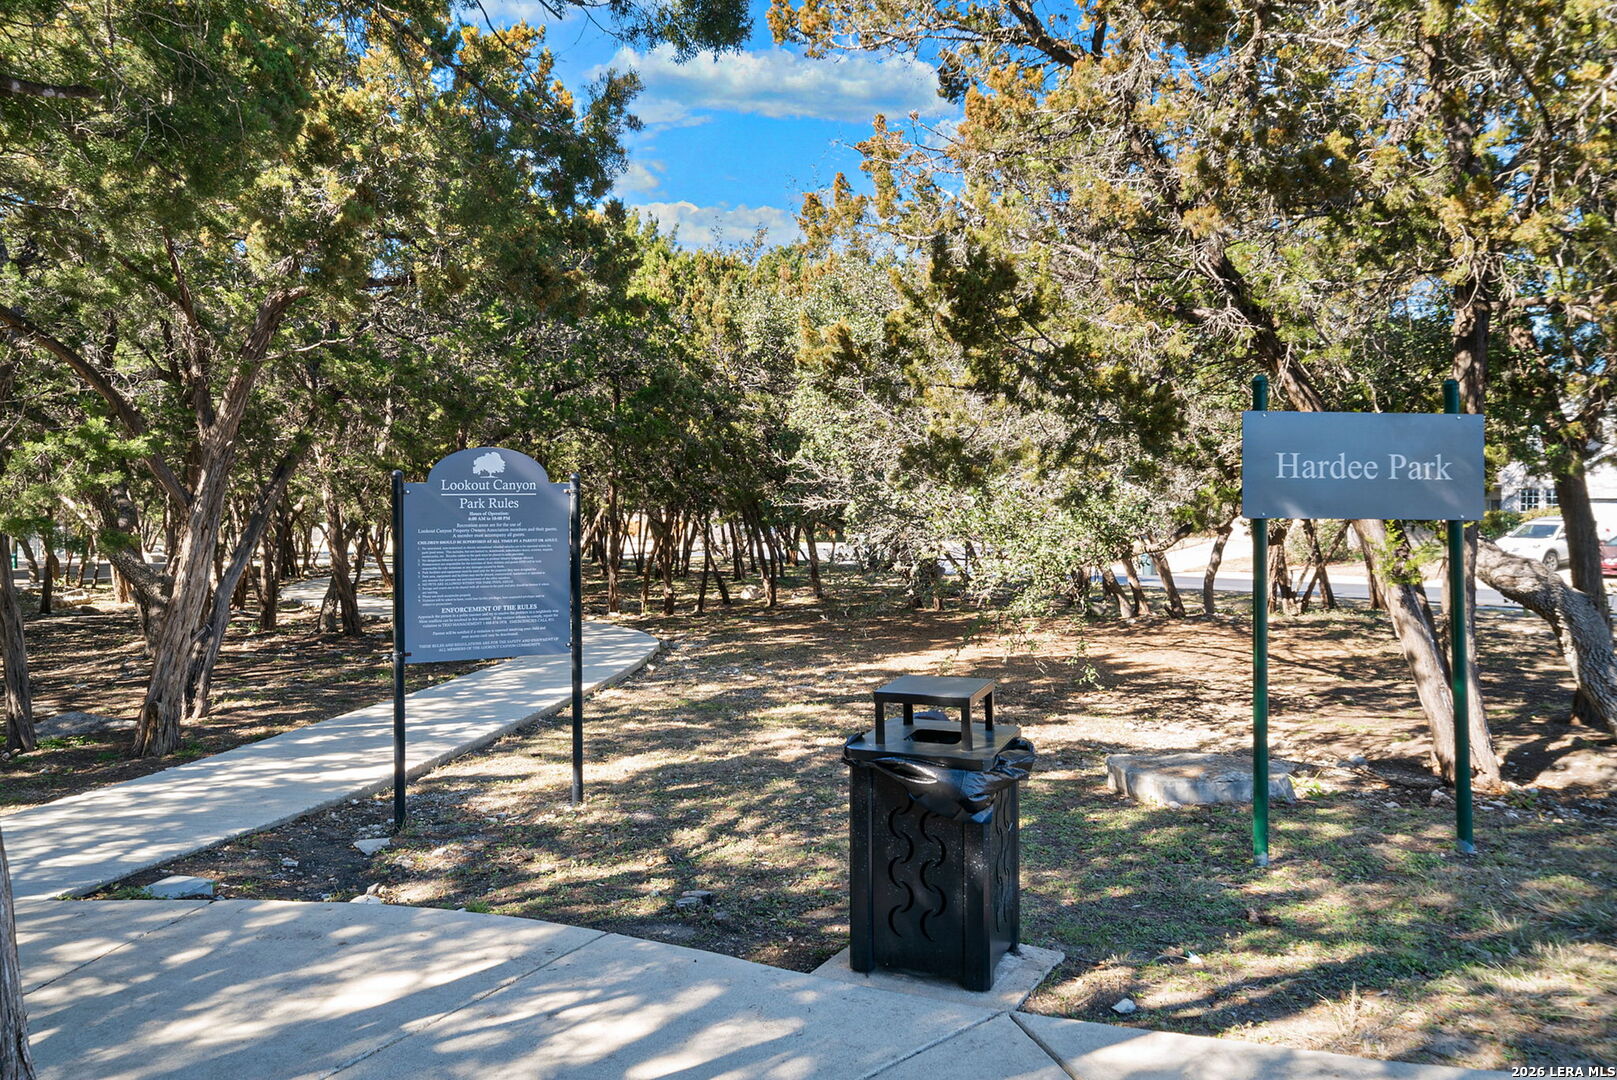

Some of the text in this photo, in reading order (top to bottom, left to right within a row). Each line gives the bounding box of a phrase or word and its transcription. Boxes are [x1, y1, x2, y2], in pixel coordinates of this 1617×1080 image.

[1275, 452, 1454, 481] Hardee Park
[441, 479, 536, 492] Lookout Canyon
[460, 498, 519, 509] Park Rules
